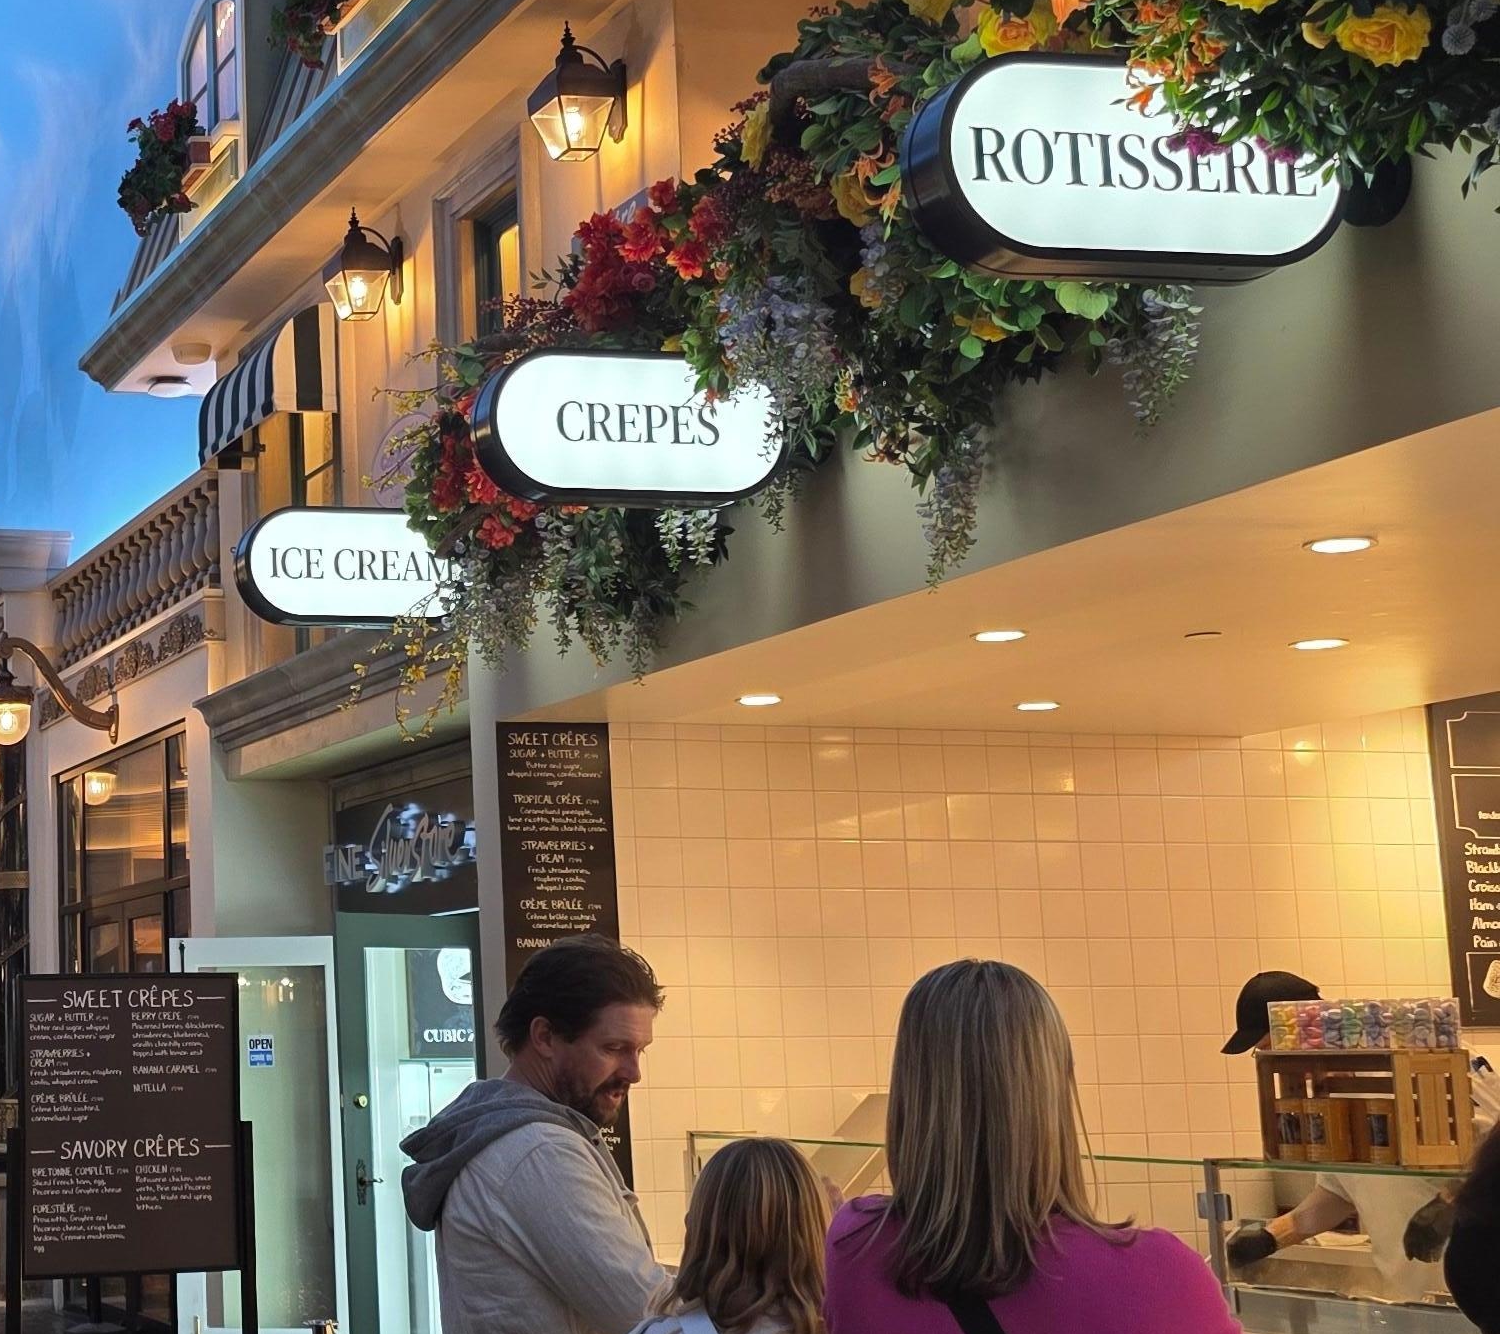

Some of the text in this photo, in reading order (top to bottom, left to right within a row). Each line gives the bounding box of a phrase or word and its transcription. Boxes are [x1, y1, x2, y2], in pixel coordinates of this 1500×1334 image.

[968, 125, 1317, 197] ROTISSERIE
[557, 400, 721, 446] CREPES
[269, 547, 453, 582] ICE CREAM
[508, 730, 598, 746] SWEET CRÊPES
[509, 749, 537, 758] SUGAR
[548, 749, 581, 759] BUTTER
[513, 794, 553, 805] TROPICAL
[521, 840, 587, 851] STRAWBERRIES
[535, 853, 565, 863] CREAM
[1469, 898, 1494, 911] Ham
[516, 938, 552, 948] BANANA
[1473, 935, 1497, 948] Pain
[62, 984, 194, 1009] SWEET CRÊPES
[29, 1012, 55, 1022] SUGAR
[65, 1012, 94, 1022] BUTTER
[423, 1028, 466, 1043] CUBIC
[249, 1038, 273, 1050] OPEN
[30, 1048, 85, 1058] STRAWBERRIES
[30, 1058, 55, 1068] CREAM
[133, 1065, 164, 1075] BANANA
[166, 1064, 200, 1074] CARAMEL
[133, 1082, 167, 1092] NUTELLA
[60, 1133, 200, 1160] SAVORY CRÊPES
